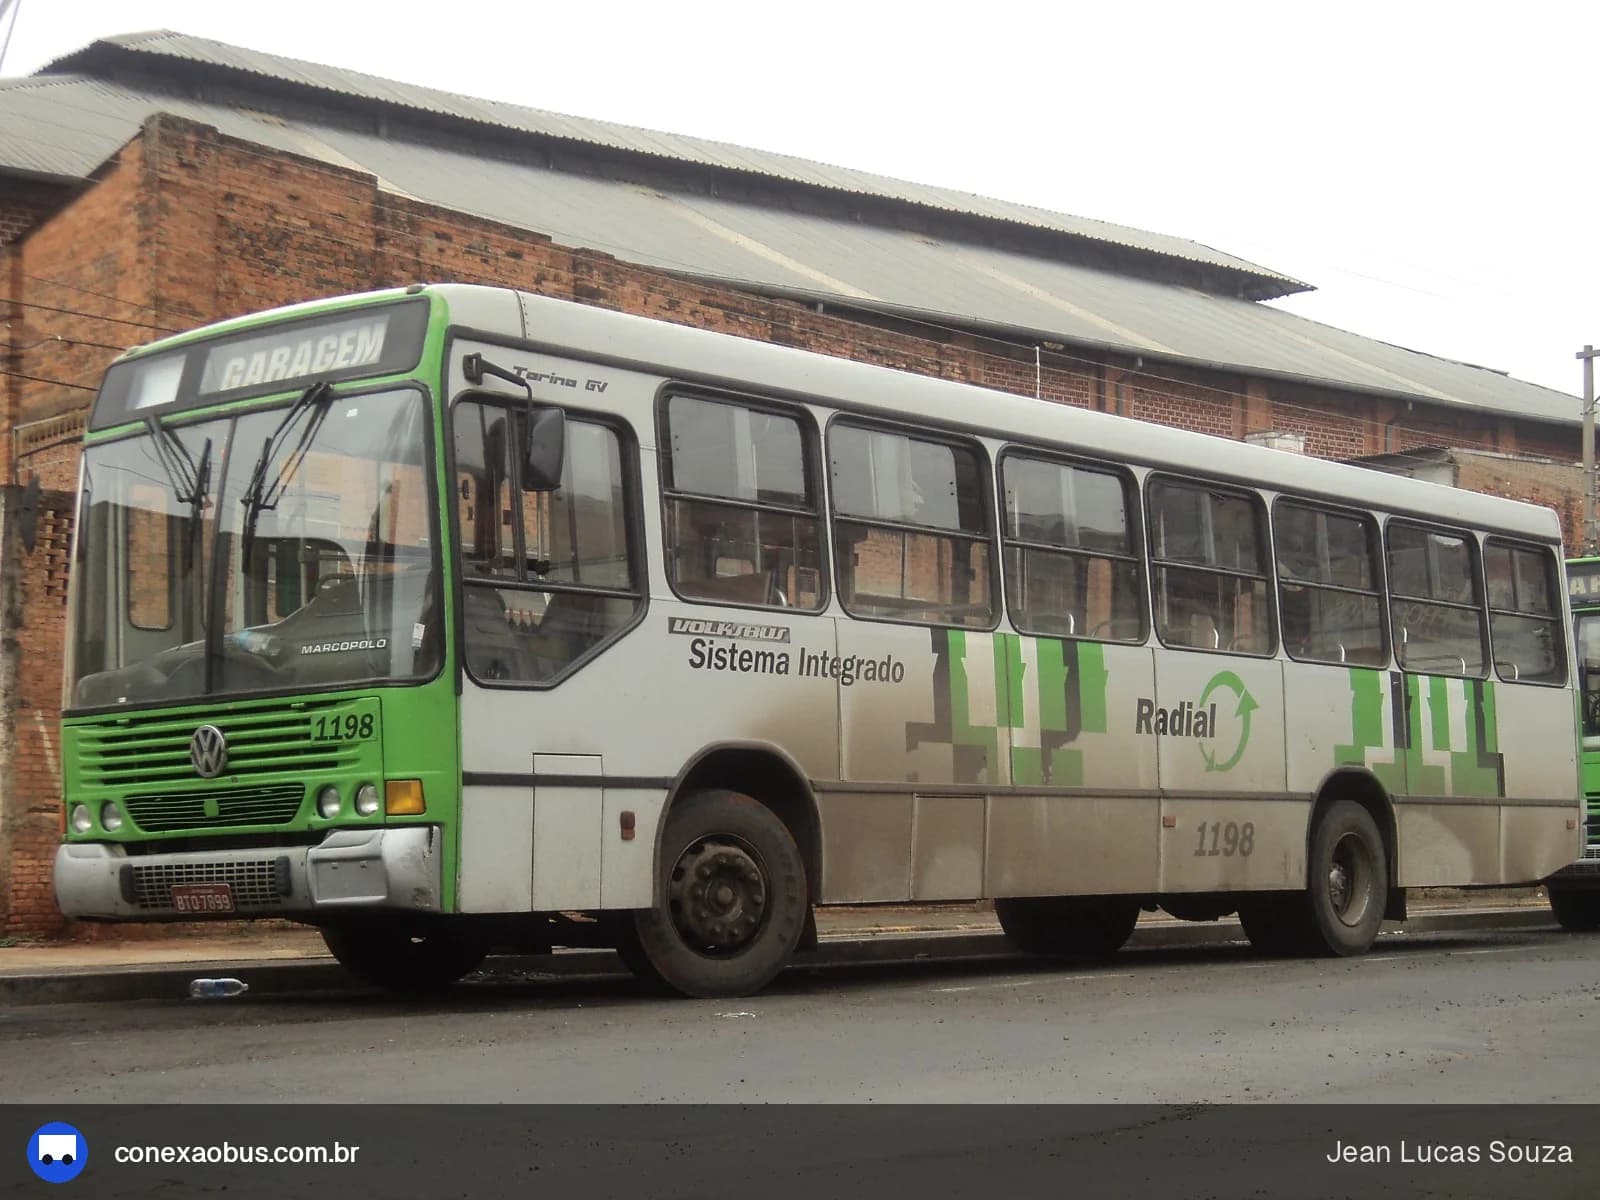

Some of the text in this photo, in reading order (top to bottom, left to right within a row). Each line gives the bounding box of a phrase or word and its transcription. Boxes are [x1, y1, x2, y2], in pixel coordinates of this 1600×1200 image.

[222, 325, 385, 390] GARAGEM
[513, 366, 609, 393] Torino GV
[301, 639, 387, 655] MARCOPOLO
[688, 638, 905, 686] Sistema Integrado
[314, 713, 374, 742] 1198
[1135, 697, 1217, 738] Radial
[1193, 821, 1255, 857] 1198
